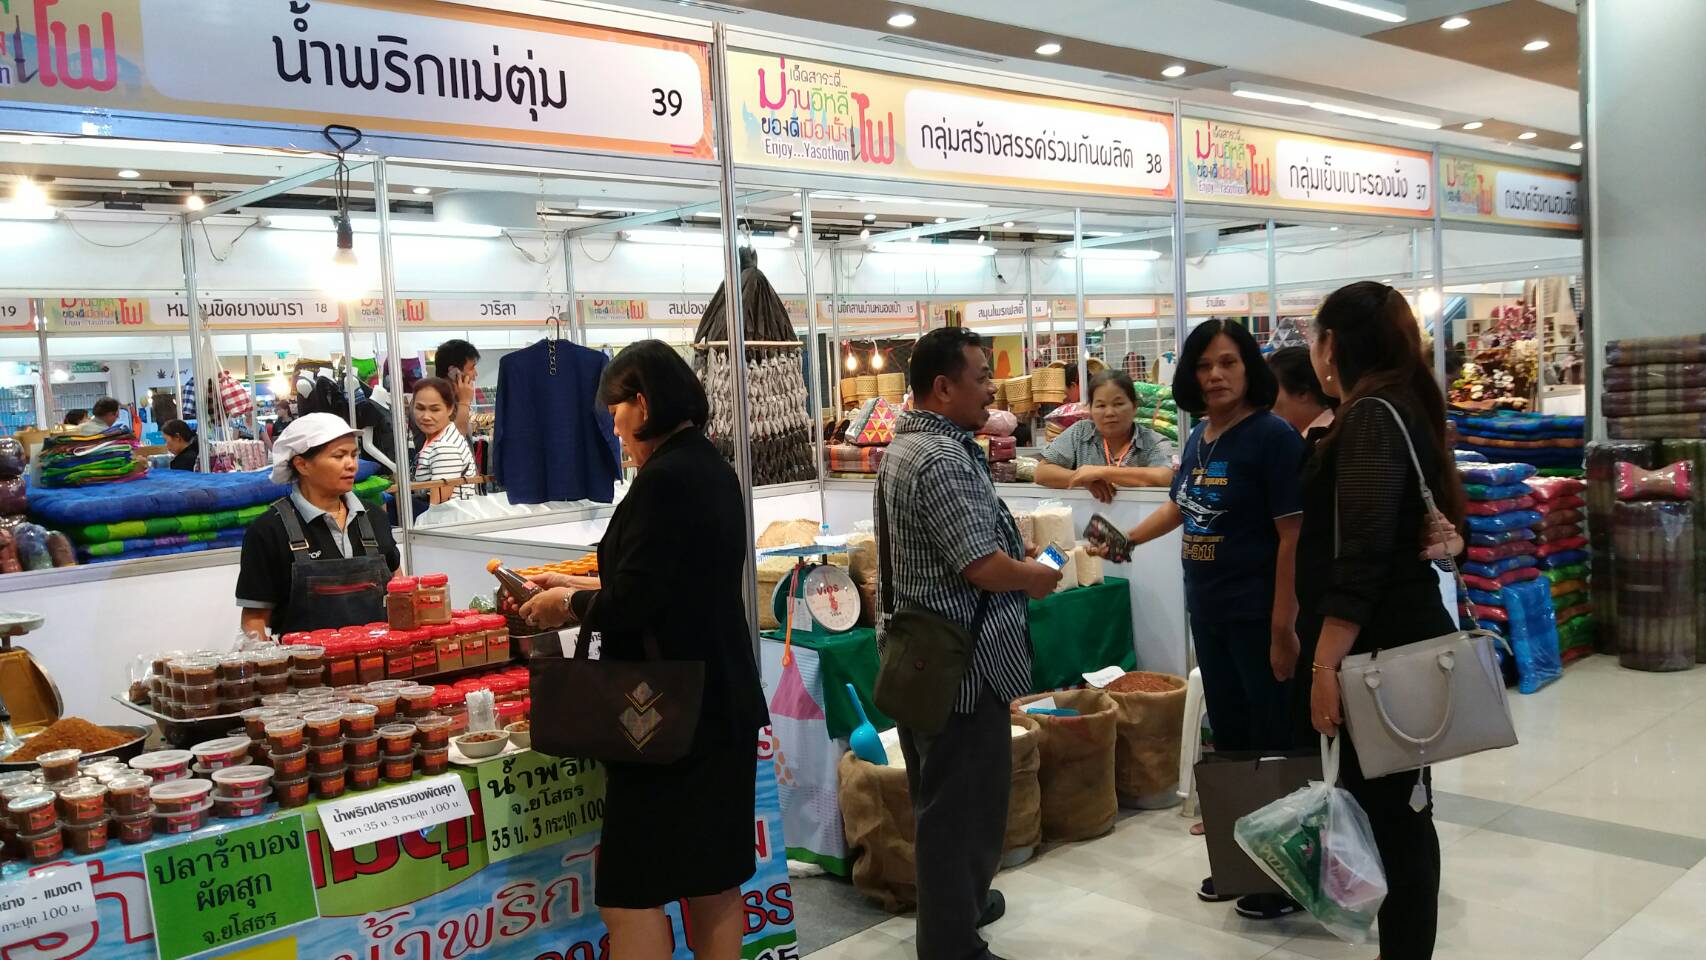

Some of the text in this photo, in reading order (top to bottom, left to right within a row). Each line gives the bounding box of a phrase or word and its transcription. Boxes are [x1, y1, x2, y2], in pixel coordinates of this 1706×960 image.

[273, 0, 683, 121] น้ำพริกแม่ตุ่ม 39
[921, 116, 1163, 174] กลุ่มสร้างสรรค์ร่วมกันผลิต 38
[1290, 154, 1427, 200] กลุ่มเย็บเบาะรองนั่ง 37
[1, 306, 17, 317] 19
[167, 299, 328, 317] หมนขิดยางพารา 18
[480, 299, 516, 316] วาริสา
[668, 300, 708, 315] สมปอง
[907, 305, 914, 314] 15
[511, 784, 585, 815] จ.ยโสธร
[363, 821, 379, 833] 35
[380, 818, 391, 828] บ.
[391, 814, 400, 825] 3
[401, 809, 429, 823] กระปุก
[431, 802, 451, 816] 100
[452, 799, 463, 809] บ.
[491, 826, 511, 852] 35
[532, 816, 542, 839] 3
[545, 811, 577, 837] กระปุก
[580, 798, 605, 825] 100
[153, 829, 301, 885] ปลาร้าบอง
[0, 894, 26, 912] ย่าง
[196, 873, 273, 912] ผัดสุก
[1, 915, 38, 933] กระปุก
[42, 904, 68, 921] 100
[202, 911, 278, 945] จ.ยโสธร
